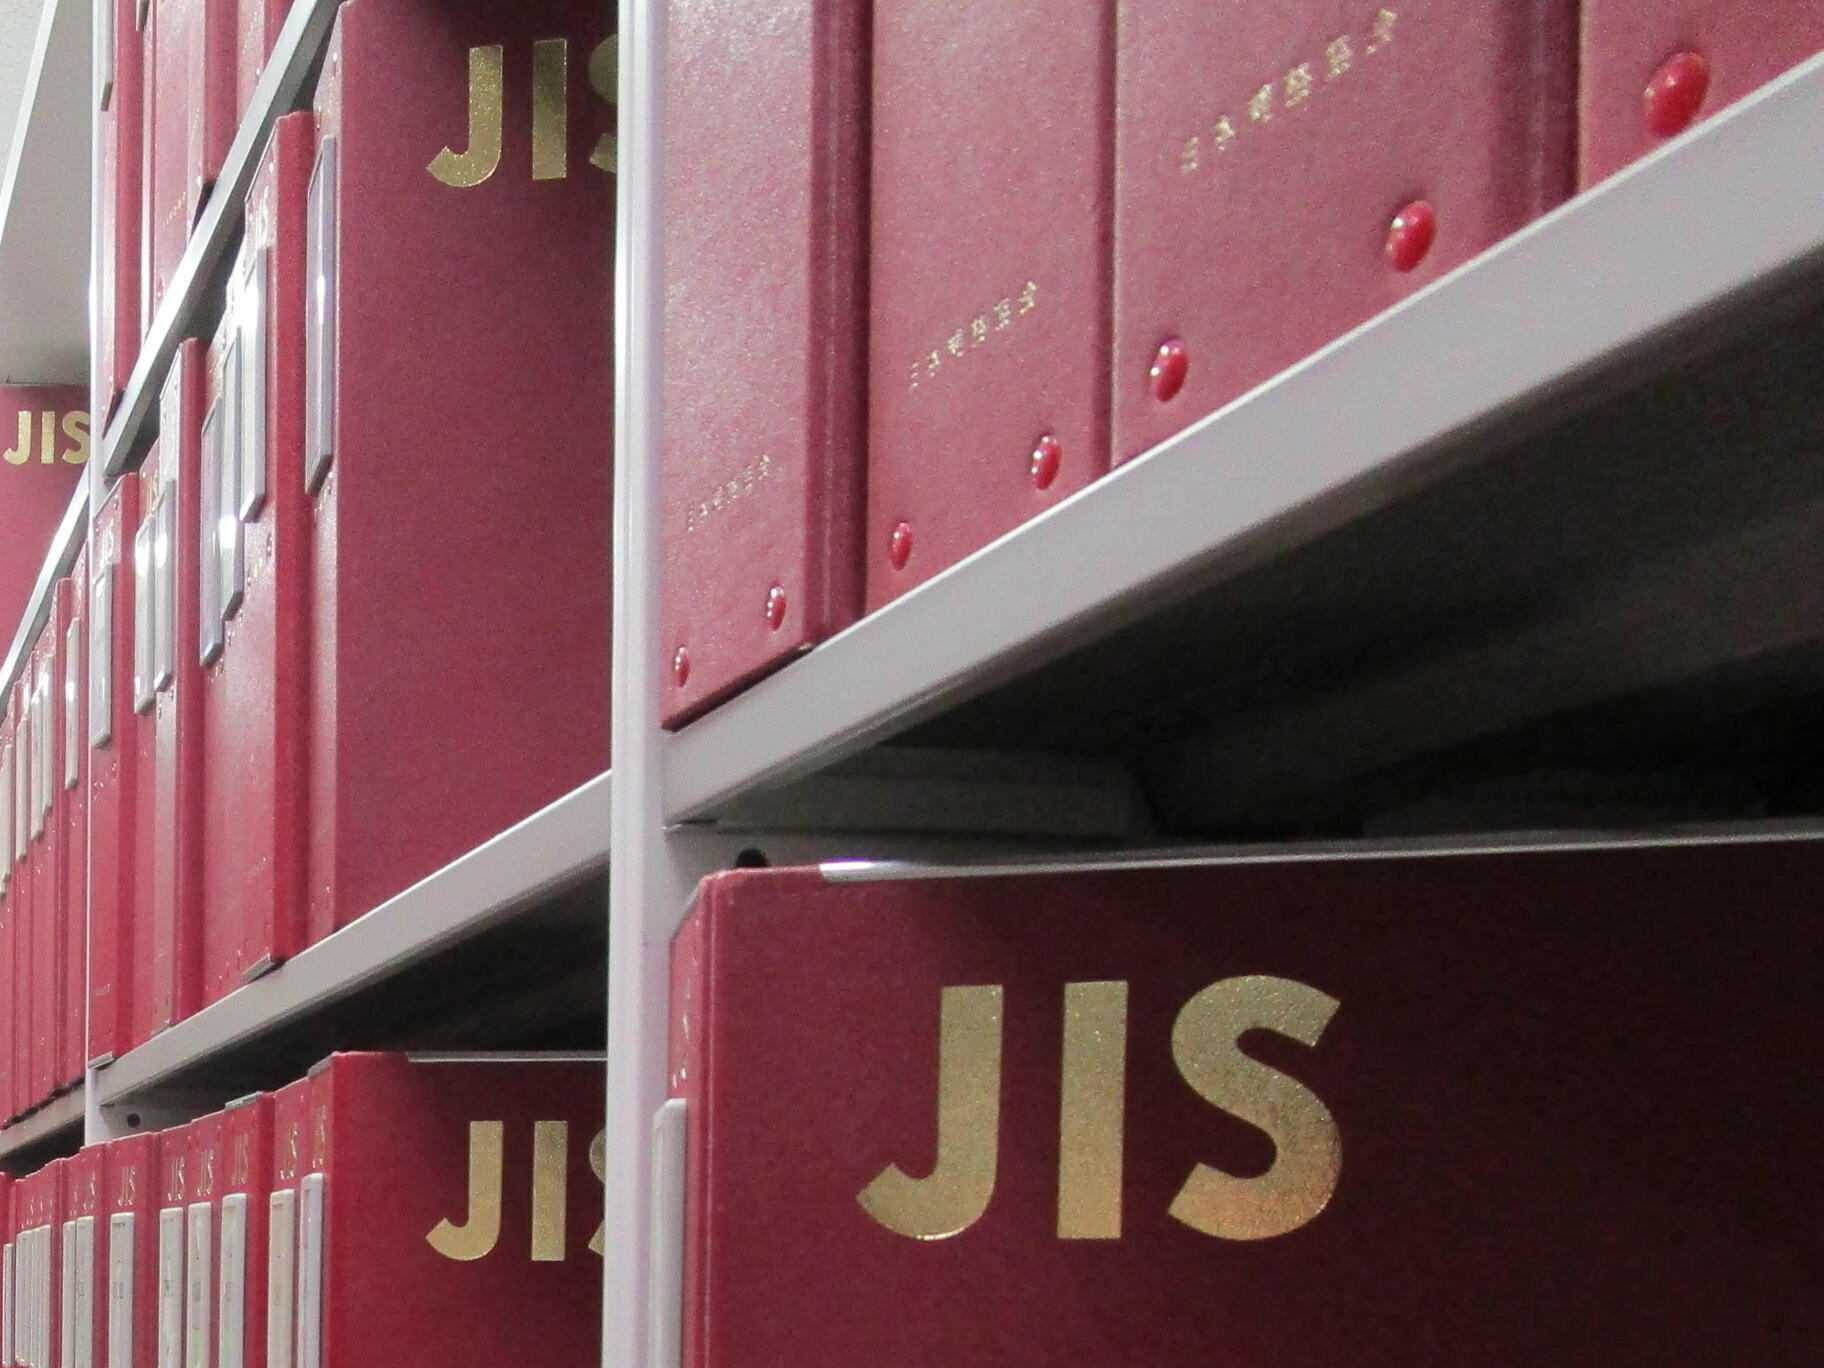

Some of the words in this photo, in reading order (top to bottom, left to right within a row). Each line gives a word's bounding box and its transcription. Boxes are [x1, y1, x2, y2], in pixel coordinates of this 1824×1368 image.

[2, 410, 90, 465] JIS
[855, 974, 1344, 1241] JIS
[168, 1156, 186, 1201] JIS
[425, 1120, 606, 1261] JI
